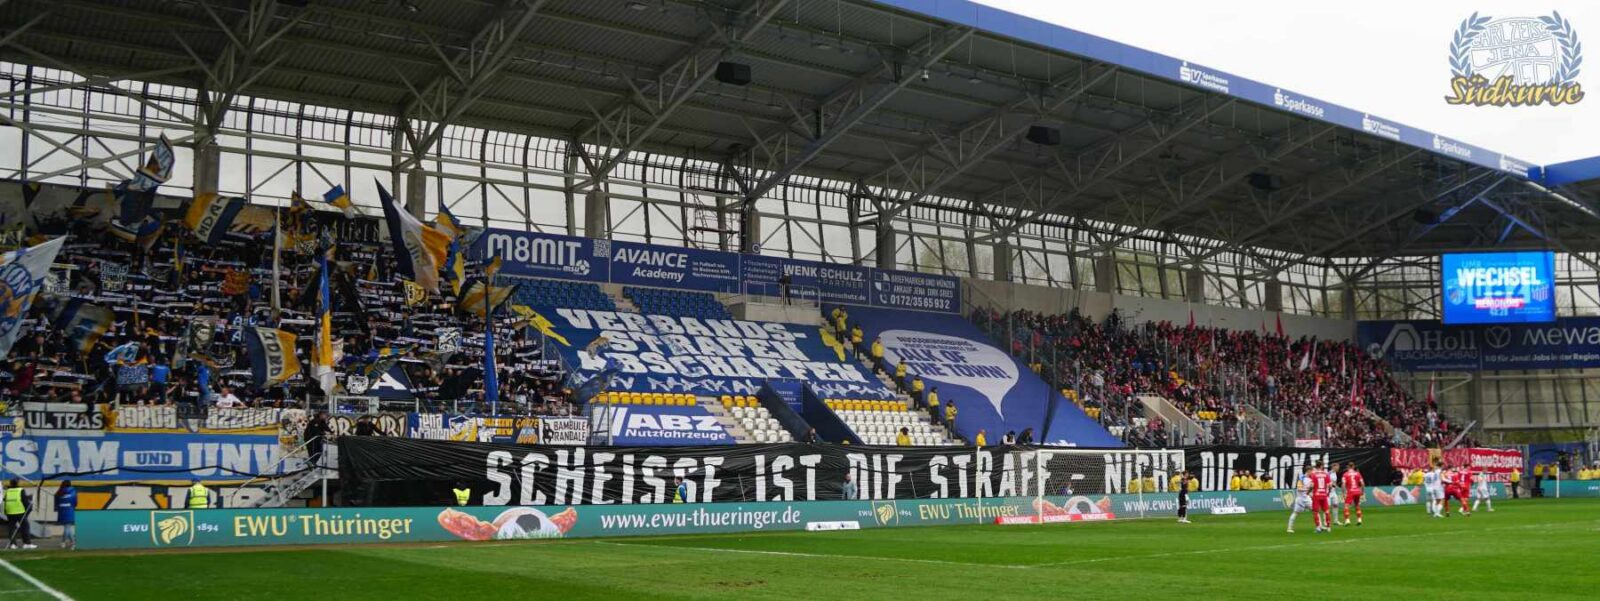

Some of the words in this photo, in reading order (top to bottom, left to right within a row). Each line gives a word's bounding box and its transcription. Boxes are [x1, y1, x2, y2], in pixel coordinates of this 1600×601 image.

[1283, 95, 1325, 118] Sparkasse
[613, 248, 688, 269] AVANCE
[632, 266, 685, 282] Academy
[784, 264, 817, 277] WENK
[1457, 266, 1541, 287] WECHSEL
[913, 287, 926, 296] JENA
[925, 279, 936, 287] UND
[556, 308, 807, 340] VERBANDS-
[601, 330, 810, 361] STRAFEN
[1424, 330, 1477, 350] Holl
[887, 347, 945, 363] TALK
[944, 350, 969, 364] OF
[1533, 353, 1551, 362] Jobs
[1559, 353, 1572, 361] der
[576, 350, 870, 383] ABSCHAFFEN
[908, 361, 949, 376] THE
[944, 363, 1012, 380] TOWN!
[27, 411, 104, 430] ULTRAS
[553, 420, 586, 431] BAMBULE
[626, 414, 722, 431] ABZ
[553, 431, 586, 441] RANDALE
[625, 429, 727, 441] Nutzfahrzeuge
[0, 439, 120, 476] SAM
[136, 452, 173, 466] UND
[483, 447, 725, 506] SCHEISSE
[755, 454, 822, 502] IST
[847, 453, 904, 501] DIE
[929, 451, 1052, 500] STRAFE
[600, 505, 801, 529] www.ewu-thueringer.de
[954, 502, 1019, 522] Thüringer
[123, 524, 148, 533] EWU
[197, 523, 219, 533] 1894
[298, 513, 413, 540] Thüringer
